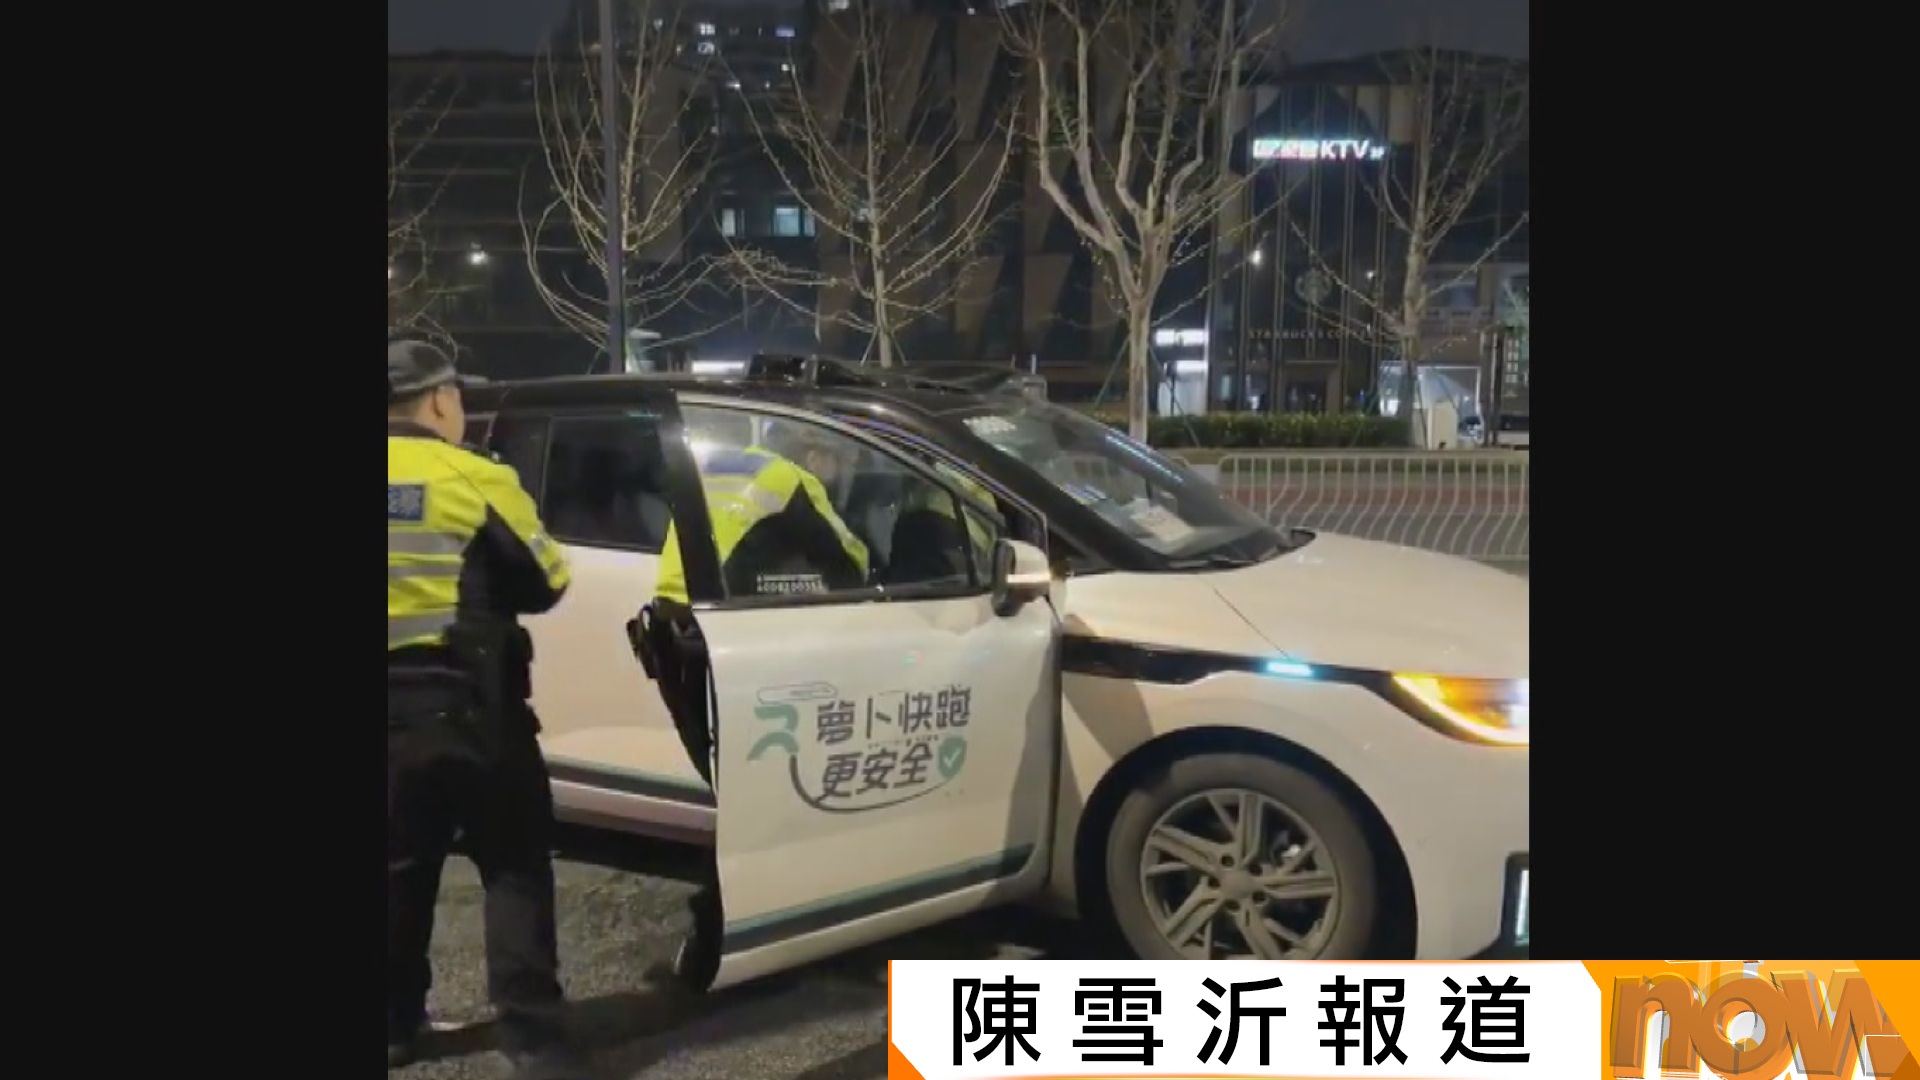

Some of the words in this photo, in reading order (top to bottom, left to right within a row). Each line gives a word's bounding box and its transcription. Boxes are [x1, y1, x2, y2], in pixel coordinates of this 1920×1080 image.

[817, 685, 970, 743] 萝卜快跑
[822, 742, 932, 797] 更安全
